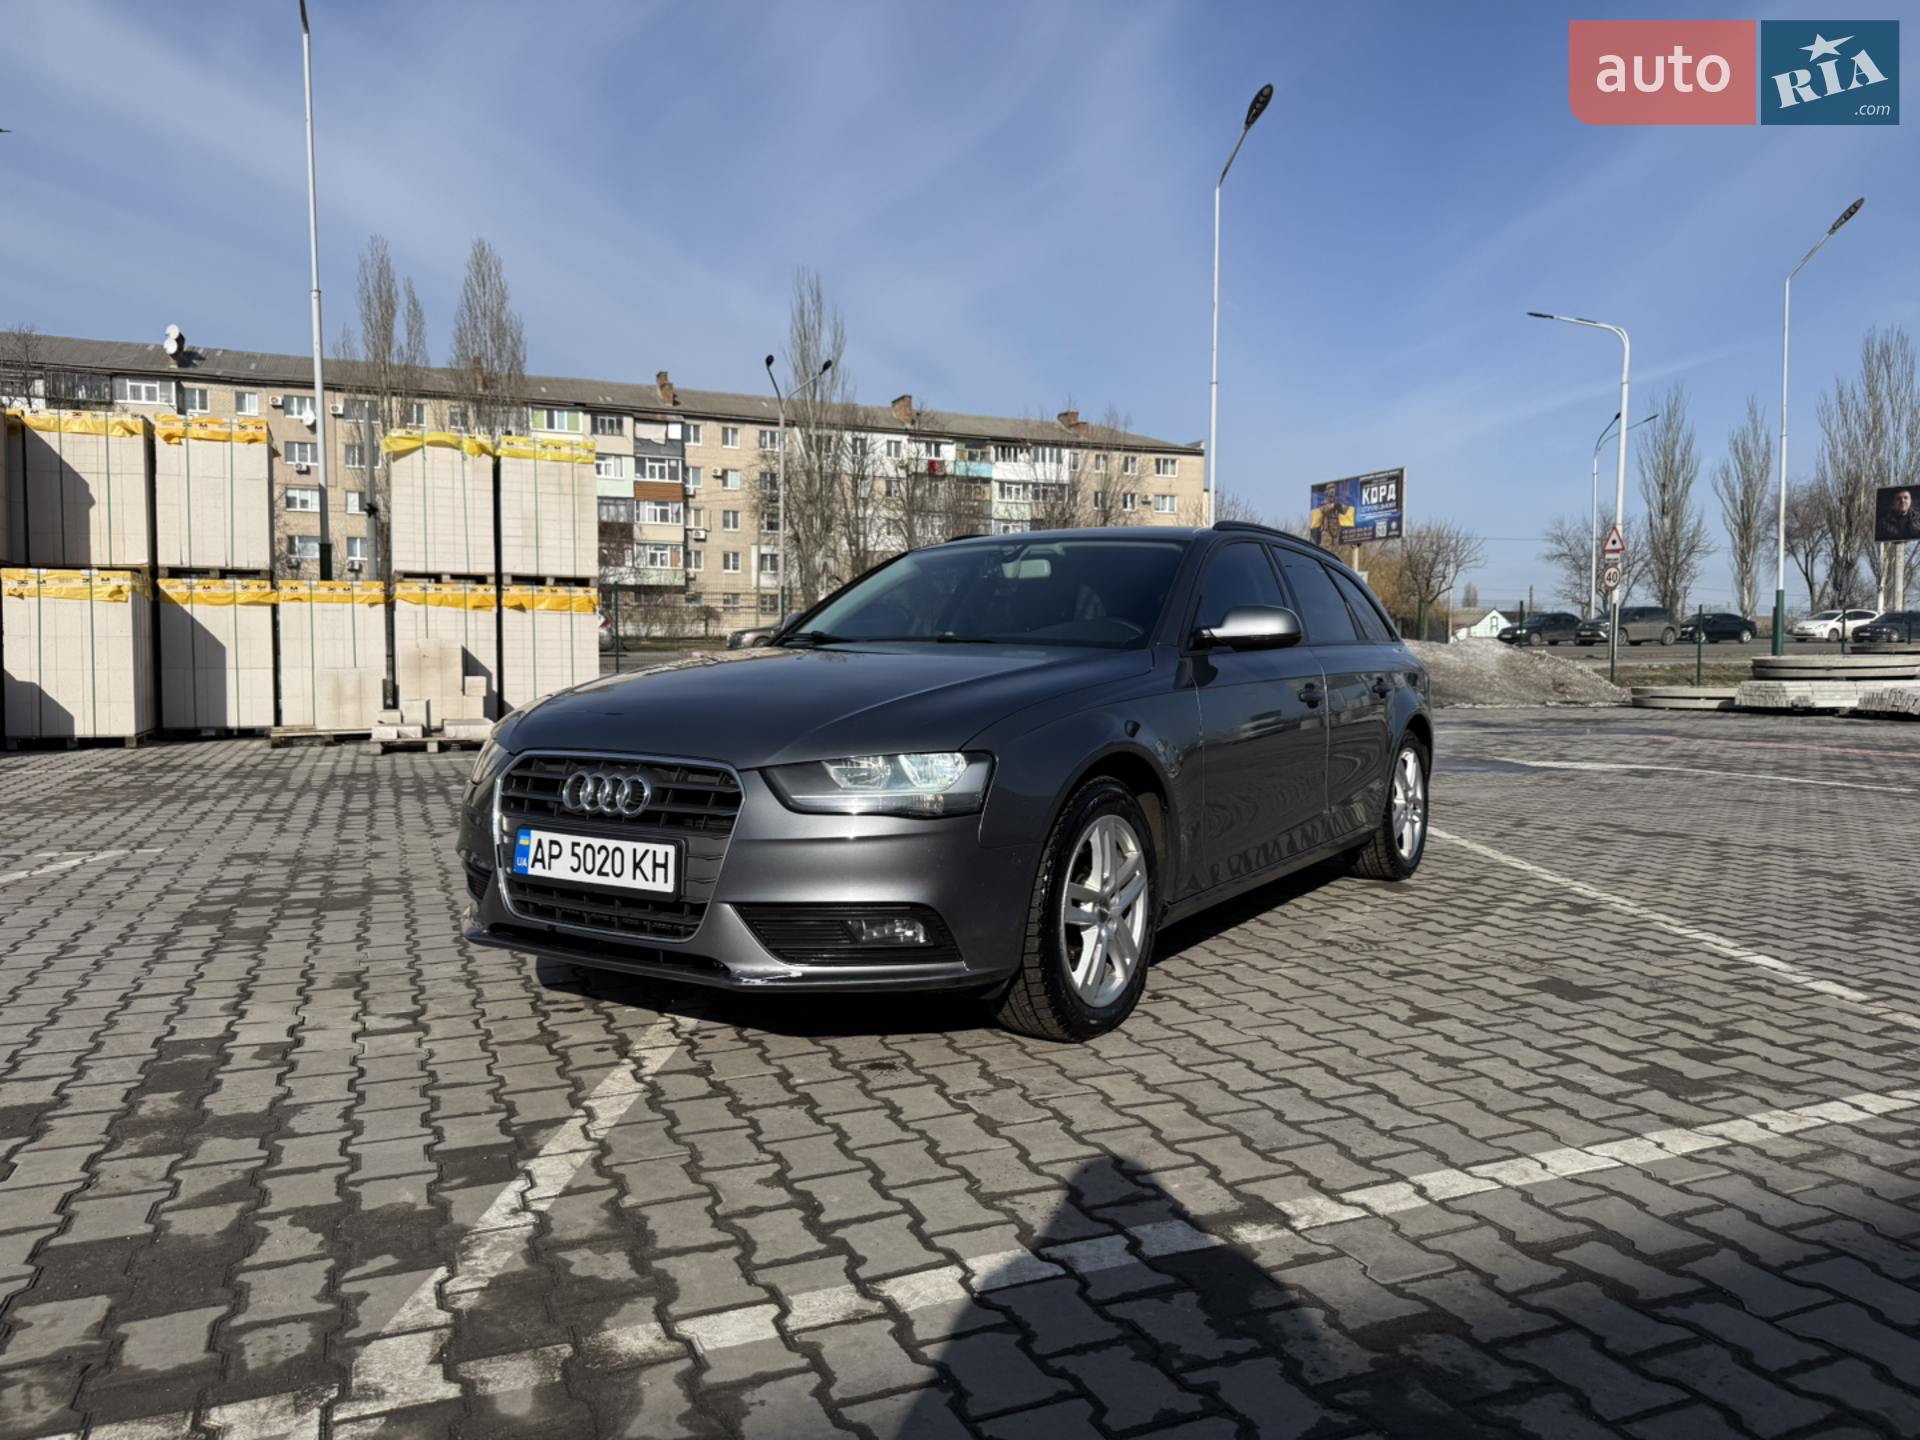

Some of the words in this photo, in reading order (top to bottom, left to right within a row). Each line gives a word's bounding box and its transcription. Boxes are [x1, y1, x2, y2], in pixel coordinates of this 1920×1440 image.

[1362, 483, 1396, 505] КОРД
[1606, 571, 1617, 583] 40
[517, 856, 527, 867] UA
[531, 838, 563, 871] AP
[570, 841, 624, 878] 5020
[632, 848, 669, 884] KH
